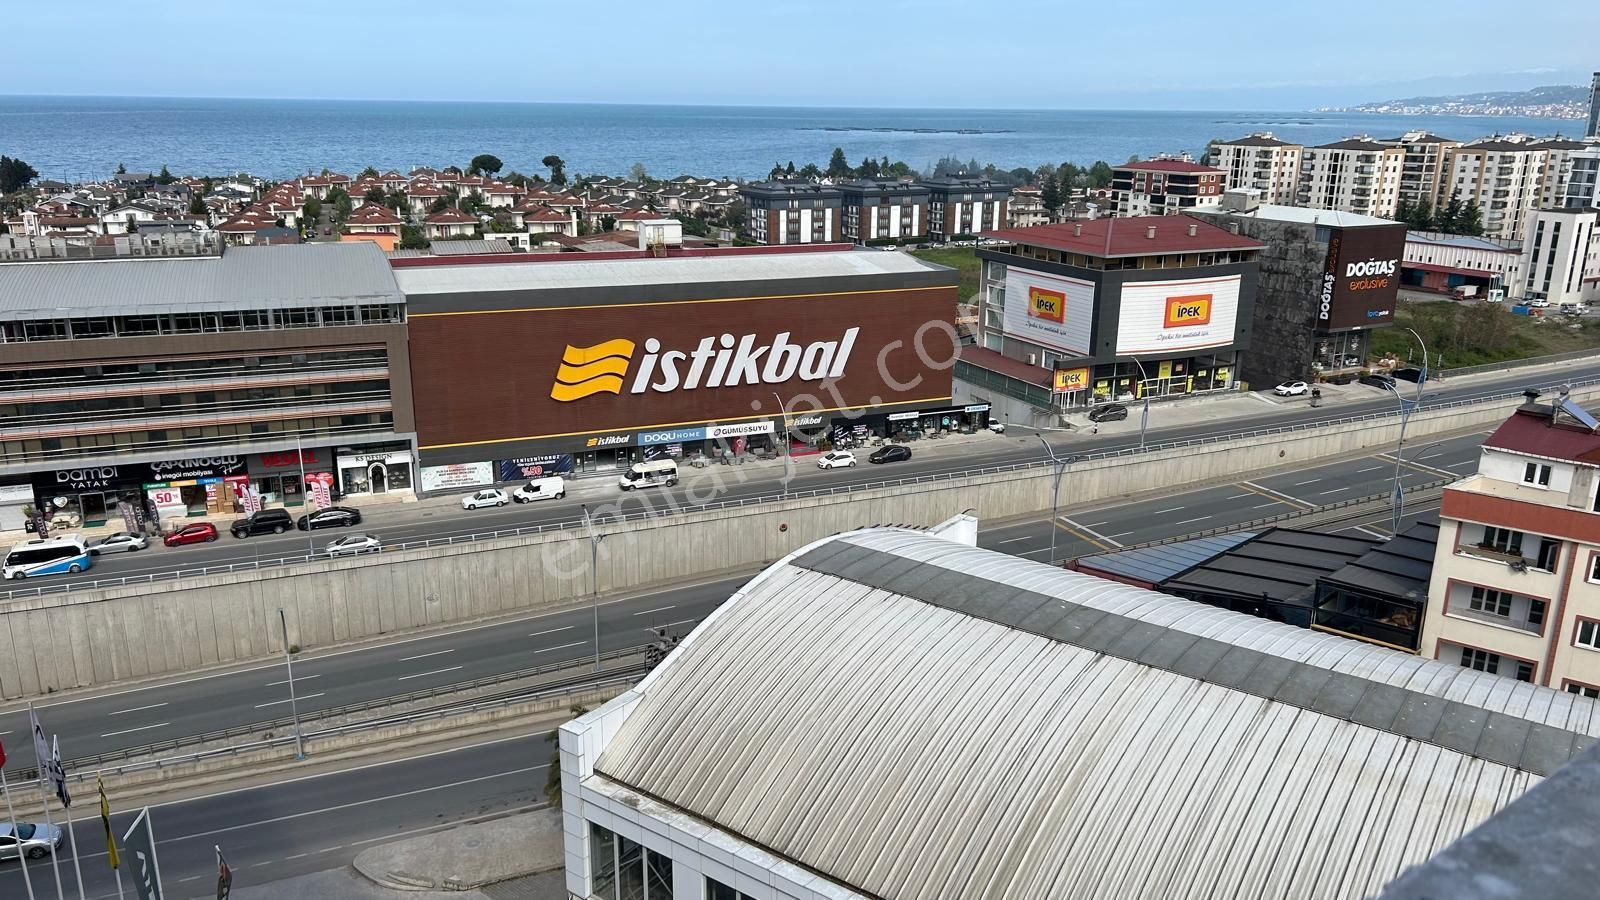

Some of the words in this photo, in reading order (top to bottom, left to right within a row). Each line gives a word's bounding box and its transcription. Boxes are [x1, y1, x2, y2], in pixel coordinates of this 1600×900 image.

[1346, 258, 1396, 277] DOĞTAŞ
[1350, 278, 1388, 291] exclusive
[1320, 273, 1336, 320] DOĞTAŞ
[1036, 296, 1055, 312] İPEK
[1177, 305, 1200, 318] İPEK
[630, 327, 860, 395] istikbal
[1062, 372, 1081, 384] İPEK
[794, 416, 823, 426] istikbal
[598, 435, 630, 446] istikbal
[644, 433, 676, 443] DOQU
[677, 431, 700, 439] HOME
[56, 465, 118, 483] bambi
[70, 480, 108, 489] YATAK
[155, 492, 173, 505] 50
